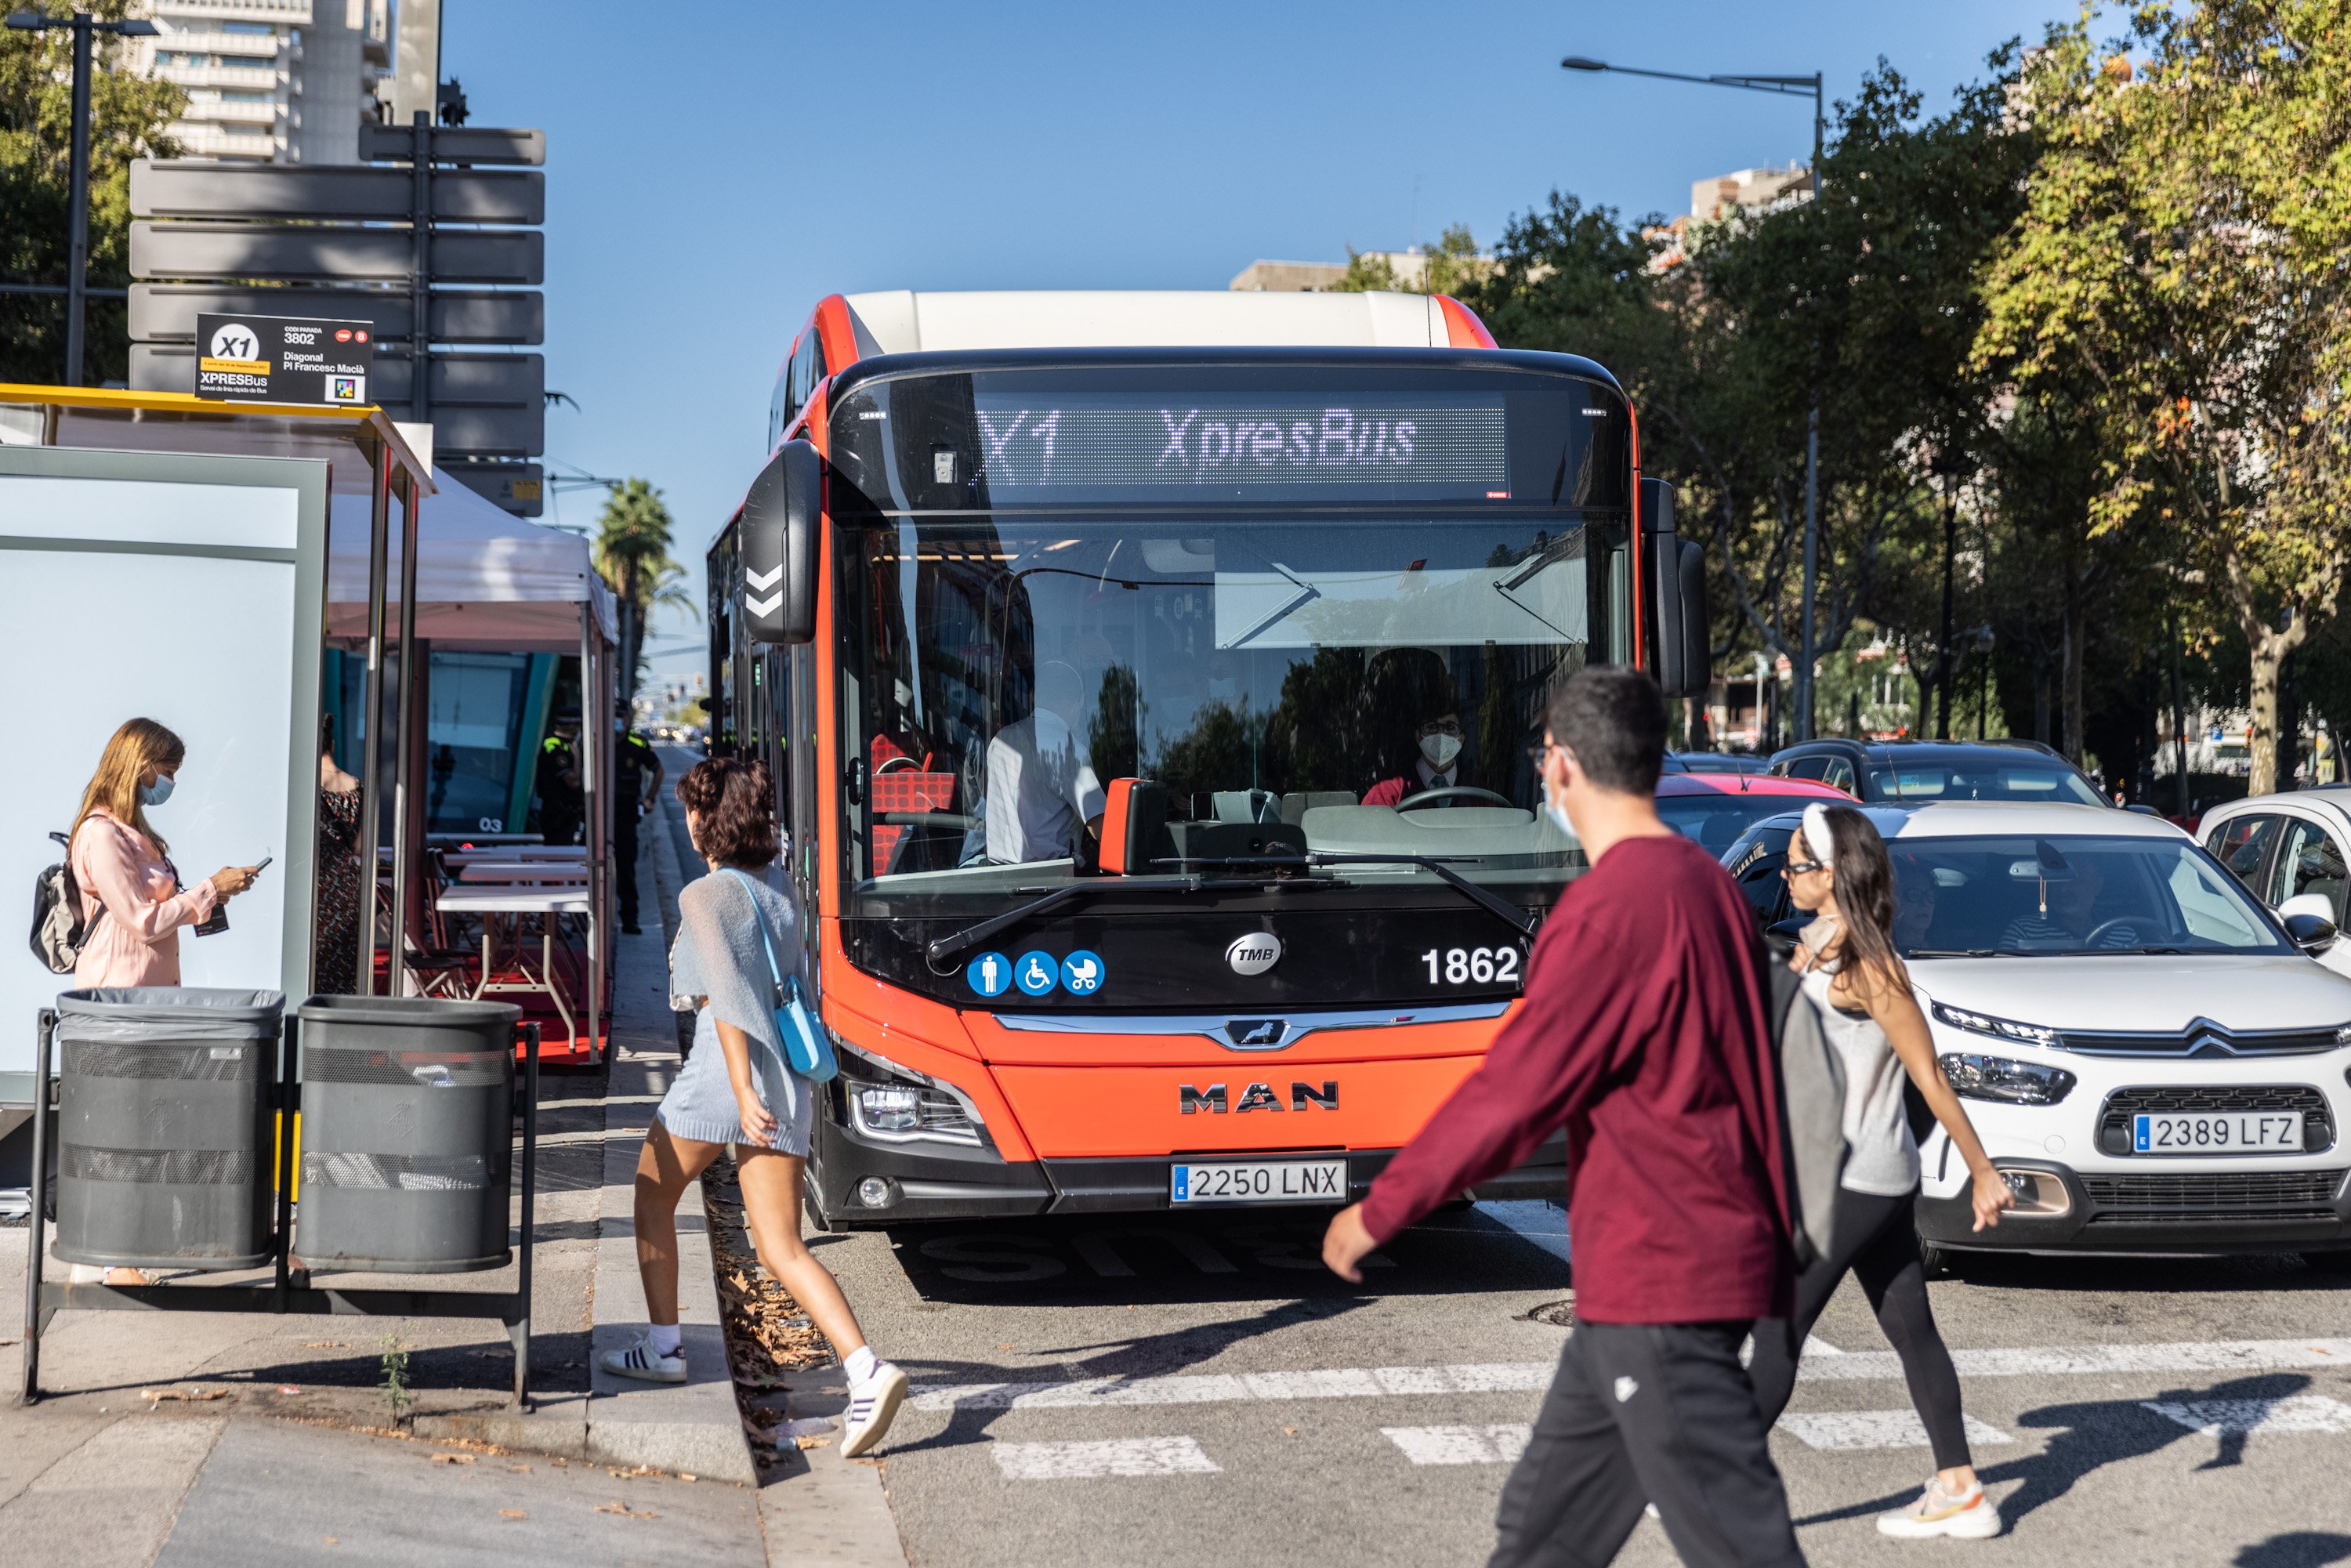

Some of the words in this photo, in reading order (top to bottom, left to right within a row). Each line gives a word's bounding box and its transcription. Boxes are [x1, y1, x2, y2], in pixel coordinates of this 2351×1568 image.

[284, 331, 315, 346] 3802
[357, 332, 365, 341] B
[218, 337, 251, 357] X1
[284, 351, 324, 363] Diagonal
[294, 361, 336, 373] Francesc
[336, 363, 365, 375] Macià
[200, 371, 268, 387] XPRESBus
[967, 409, 1060, 487] X1
[1154, 408, 1416, 485] XpresBus
[479, 817, 503, 833] 03
[1238, 947, 1275, 961] TMB
[1421, 947, 1519, 985] 1862
[1179, 1080, 1339, 1114] MAN
[2139, 1136, 2147, 1146] E
[2157, 1118, 2230, 1146] 2389
[2241, 1117, 2294, 1145] LFZ
[1177, 1186, 1185, 1195] E
[1194, 1169, 1270, 1197] 2250
[1282, 1166, 1339, 1195] LNX
